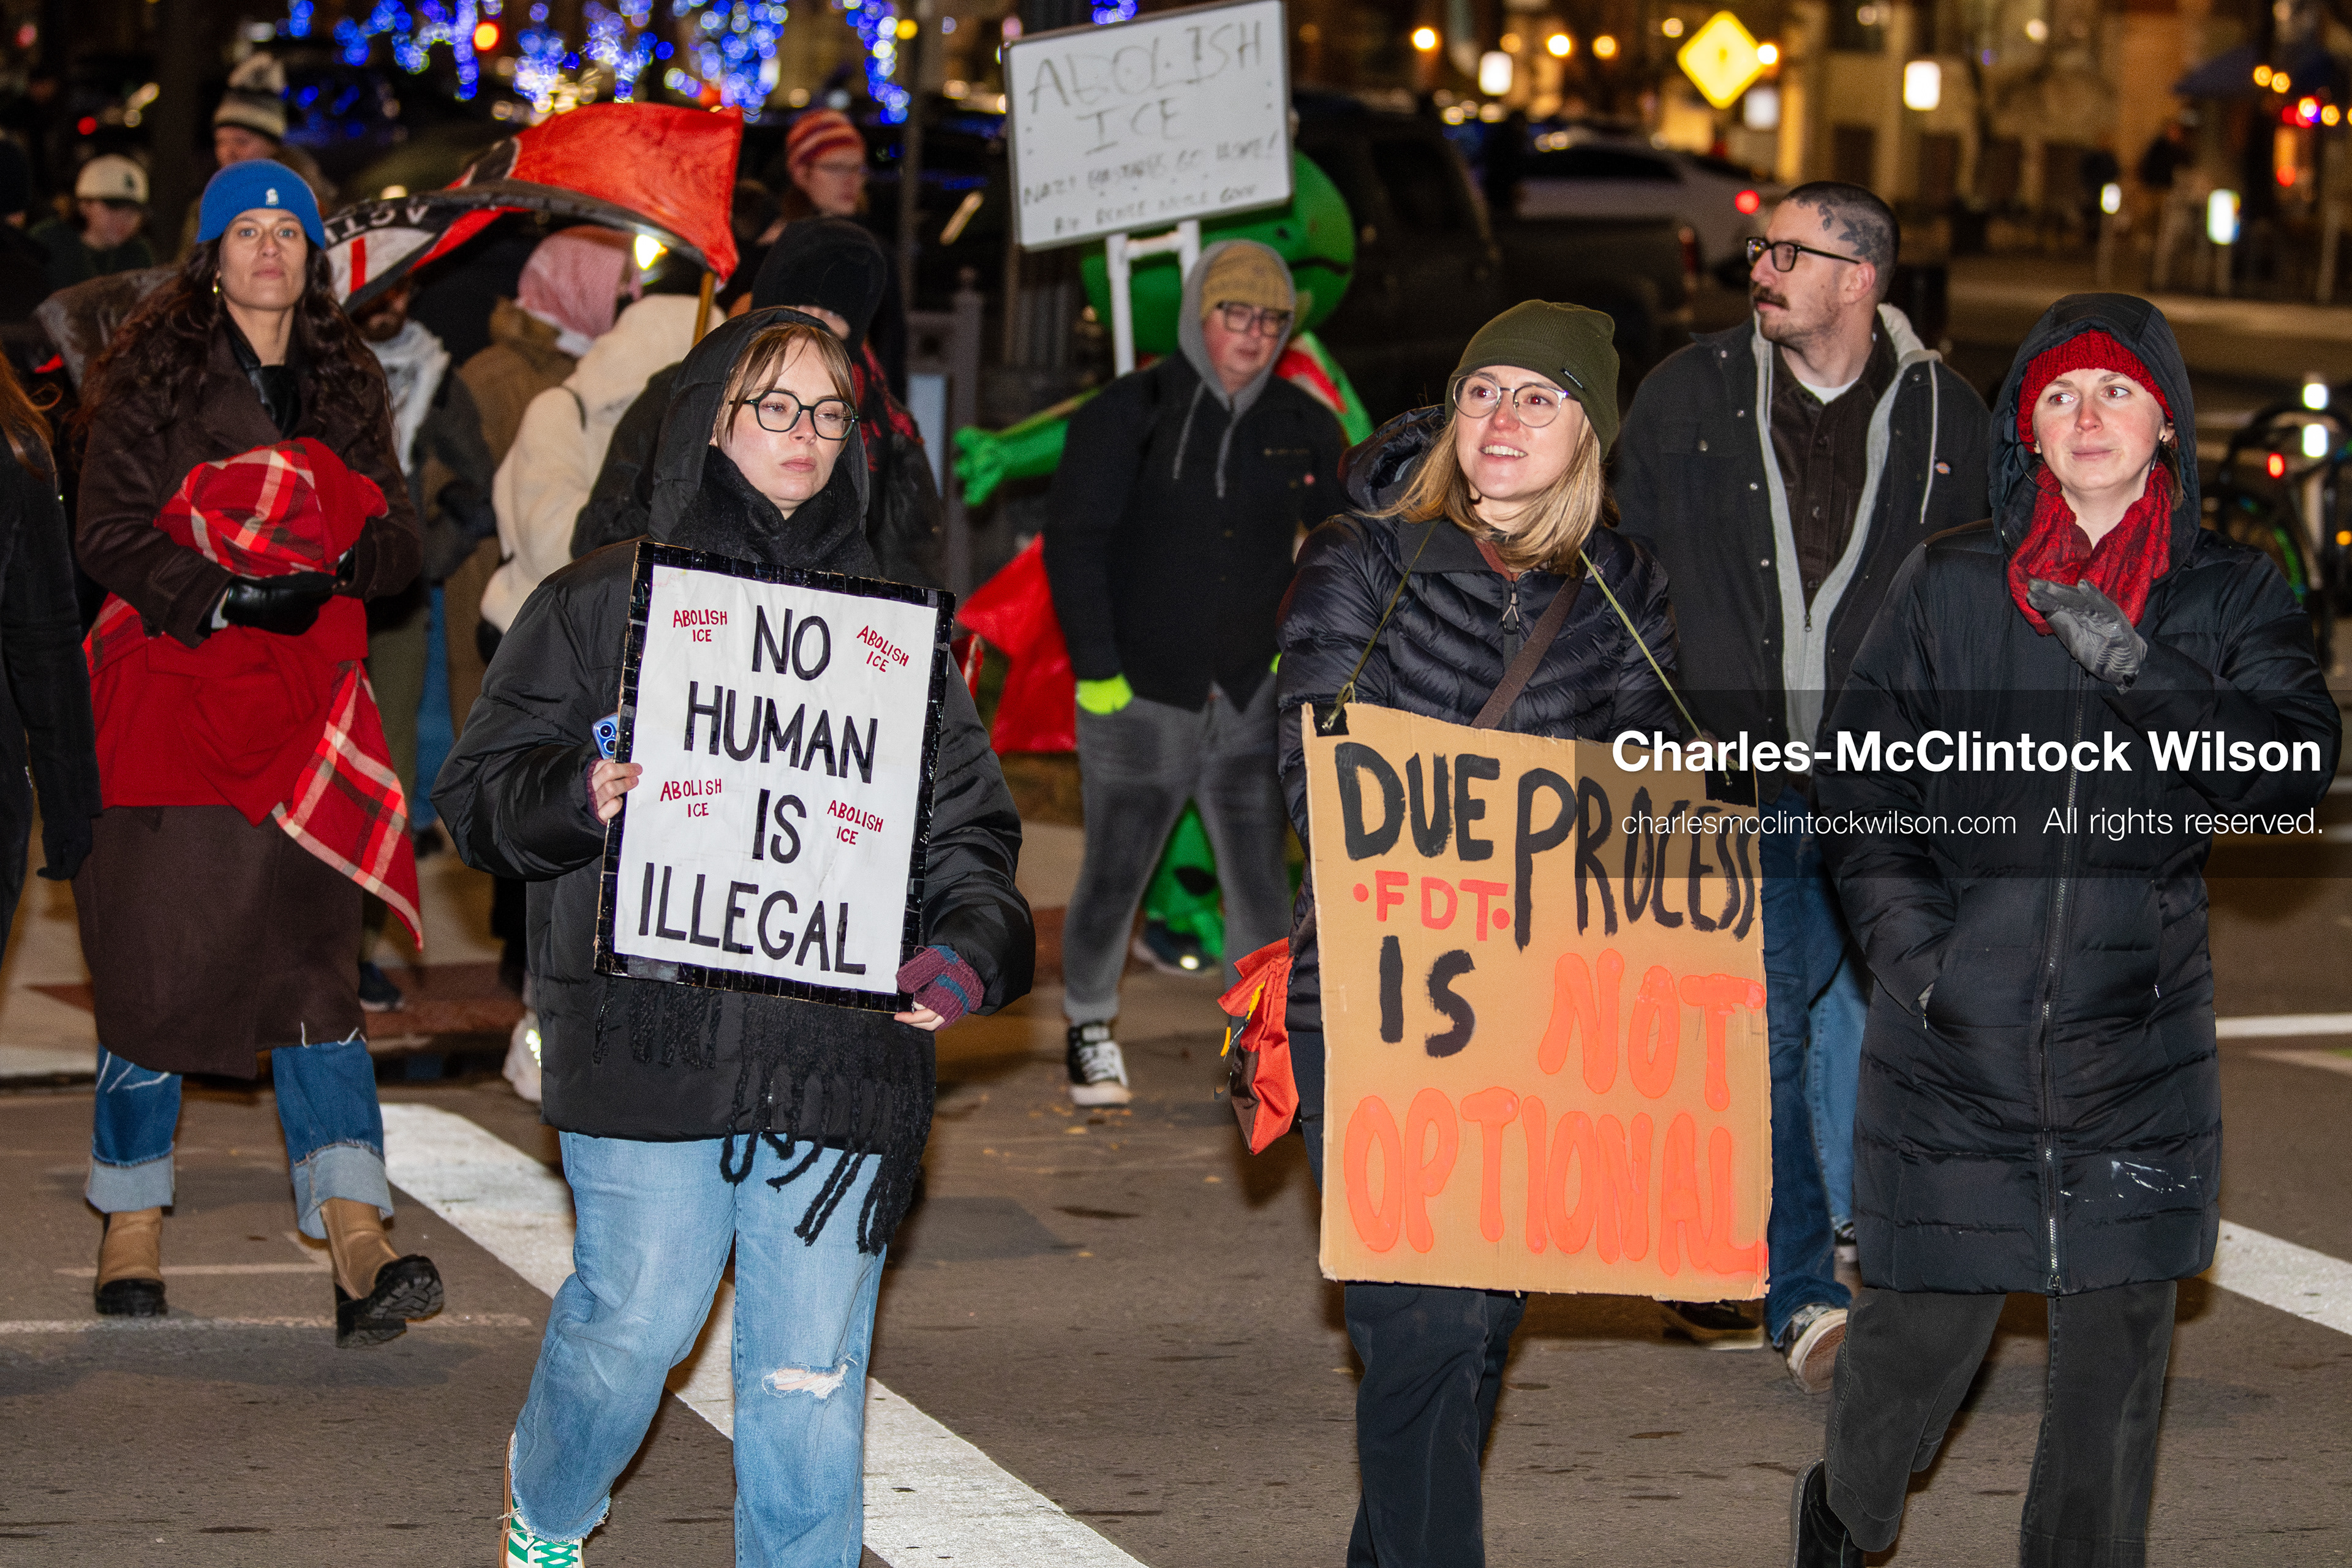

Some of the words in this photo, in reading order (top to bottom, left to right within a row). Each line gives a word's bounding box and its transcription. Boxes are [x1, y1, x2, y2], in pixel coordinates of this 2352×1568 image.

[1027, 20, 1262, 115] ABOLISH
[1076, 96, 1186, 156] ICE
[673, 609, 728, 628] ABOLISH
[692, 628, 712, 643] ICE
[752, 605, 831, 681] NO
[856, 625, 910, 666] ABOLISH
[866, 651, 889, 673] ICE
[684, 680, 878, 784] HUMAN
[660, 778, 722, 802] ABOLISH
[687, 802, 709, 818] ICE
[827, 800, 884, 832] ABOLISH
[752, 788, 807, 864] IS
[836, 826, 859, 845] ICE
[1334, 742, 1501, 861] DUE
[1514, 766, 1758, 954] PROCESS
[638, 862, 866, 975] ILLEGAL
[1378, 934, 1476, 1058] IS
[1538, 947, 1766, 1112] NOT
[1343, 1086, 1769, 1276] OPTIONAL
